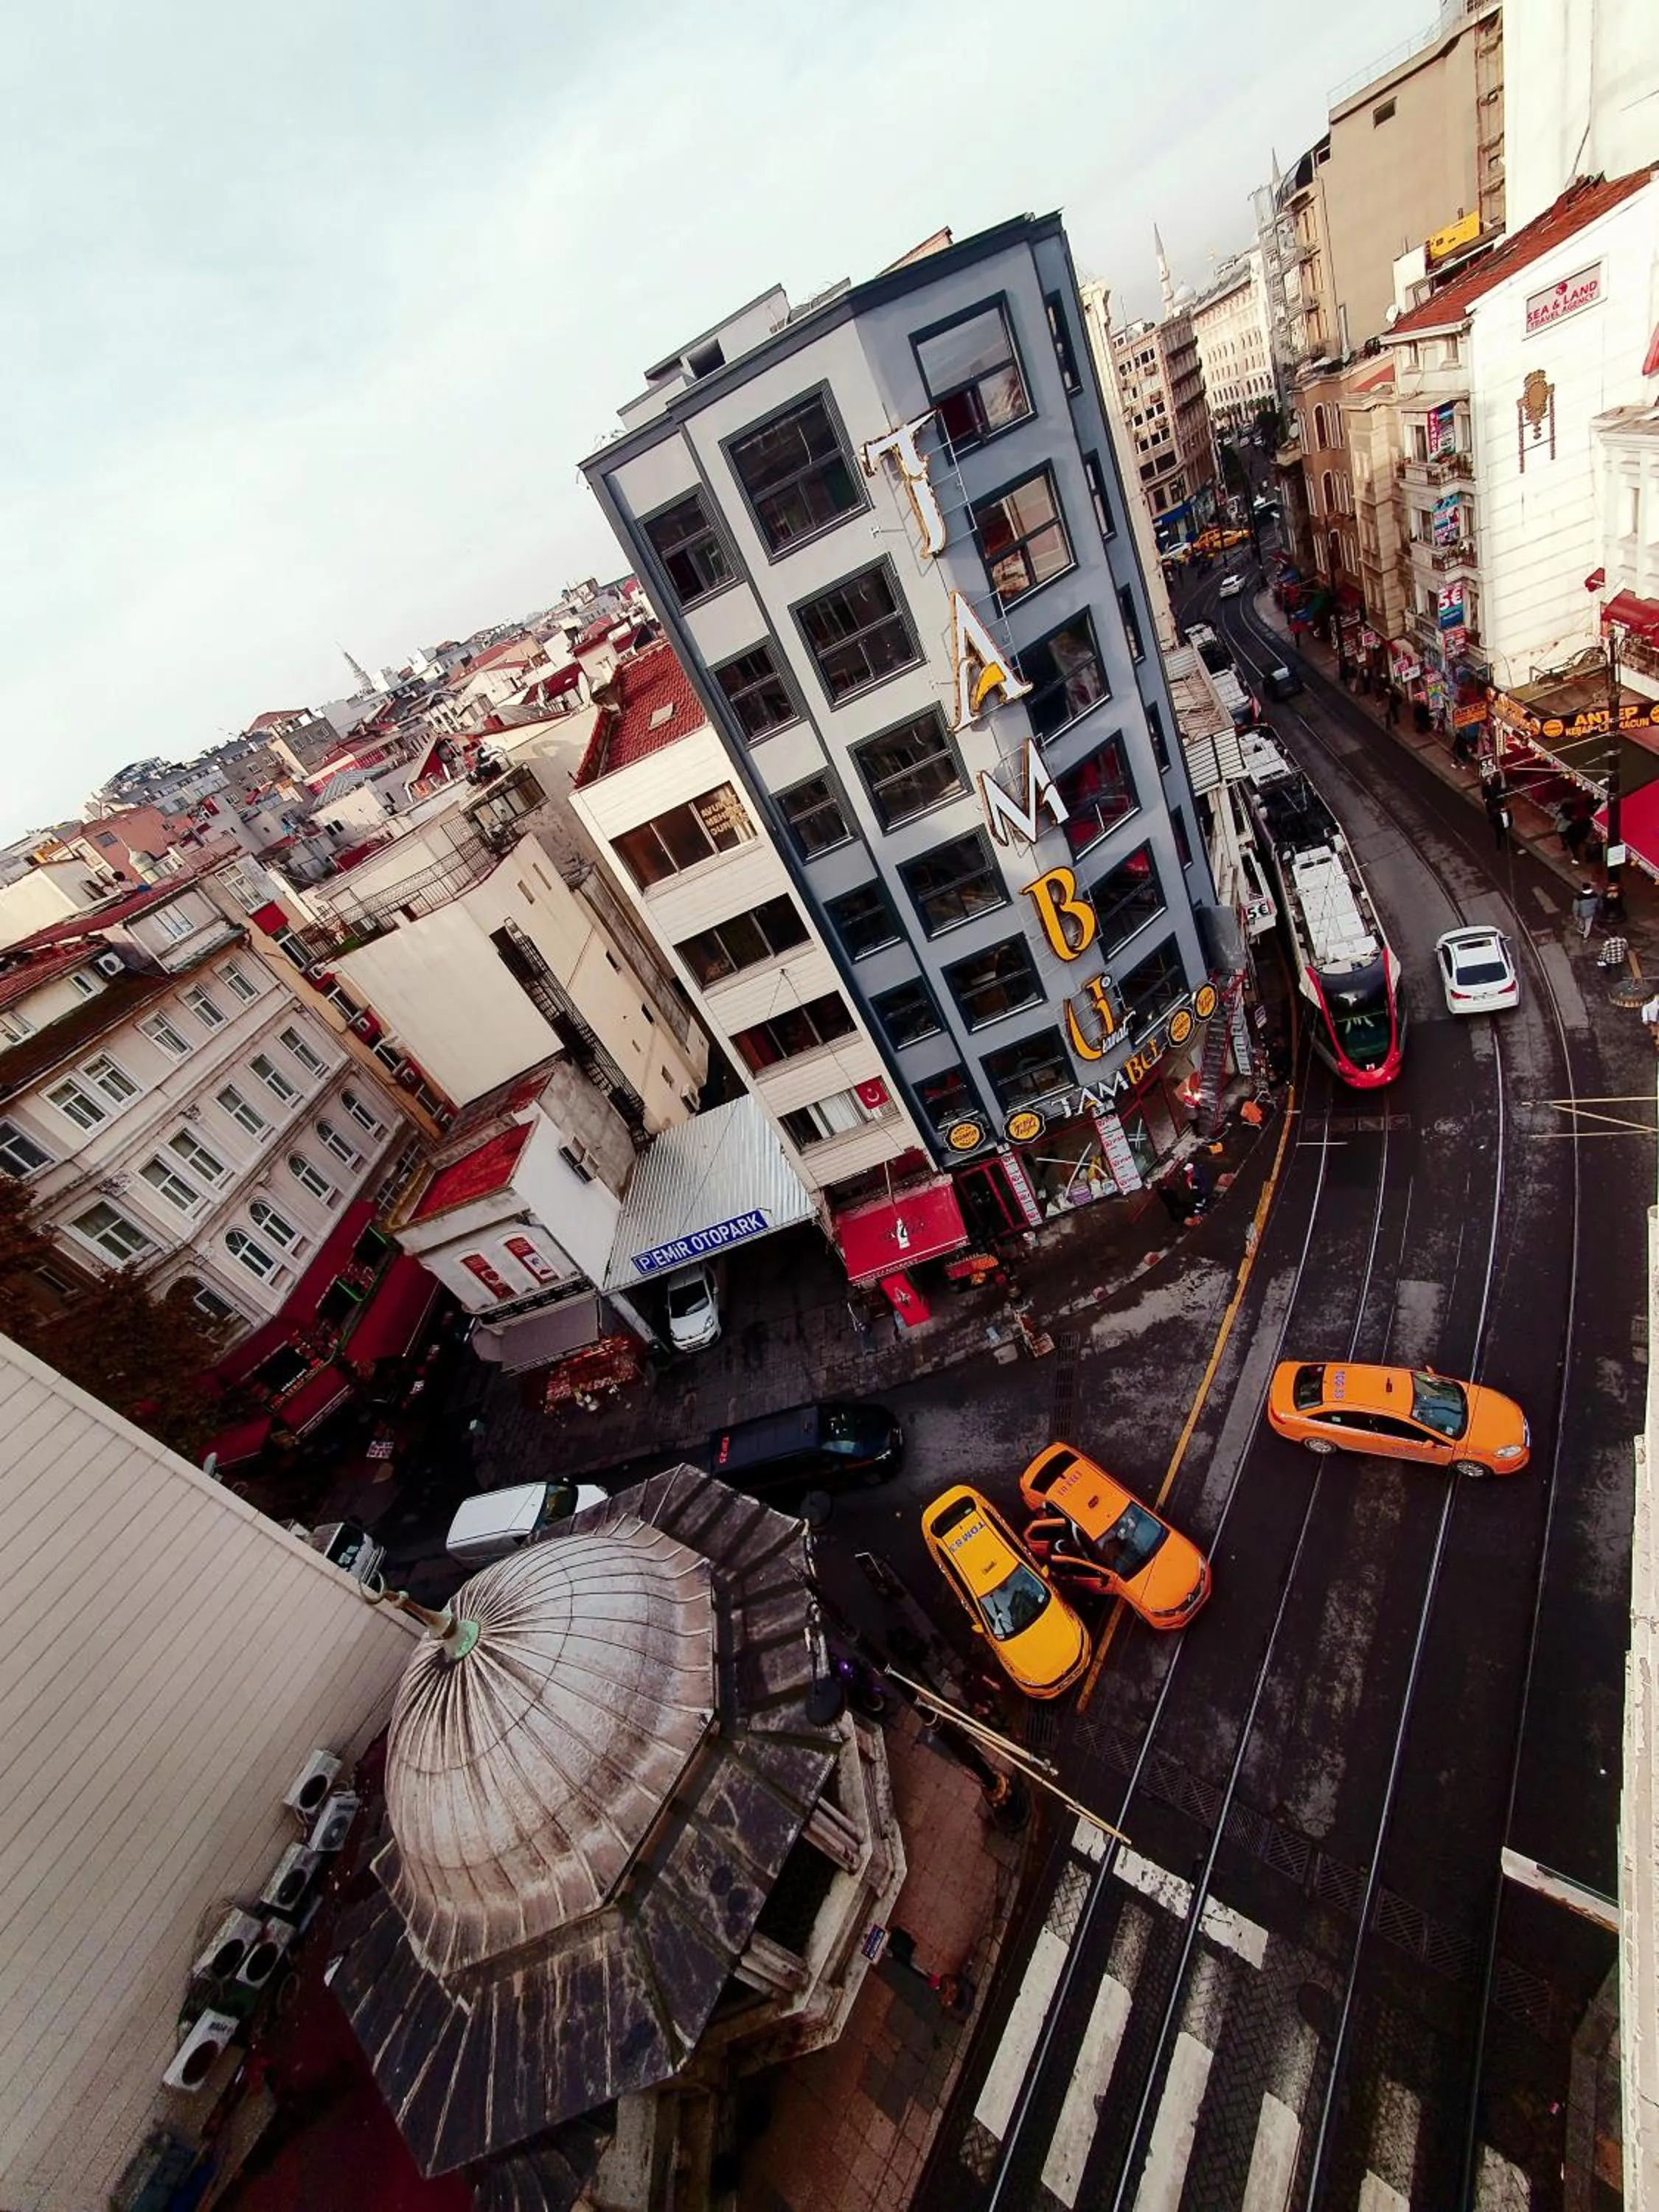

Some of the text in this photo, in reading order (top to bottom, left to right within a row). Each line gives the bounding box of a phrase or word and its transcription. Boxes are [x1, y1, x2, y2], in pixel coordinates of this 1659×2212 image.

[1528, 281, 1598, 323] SEA & LAND
[1529, 310, 1560, 328] TRAVEL
[1439, 587, 1462, 611] 5€
[691, 1214, 764, 1251] OTOPARK
